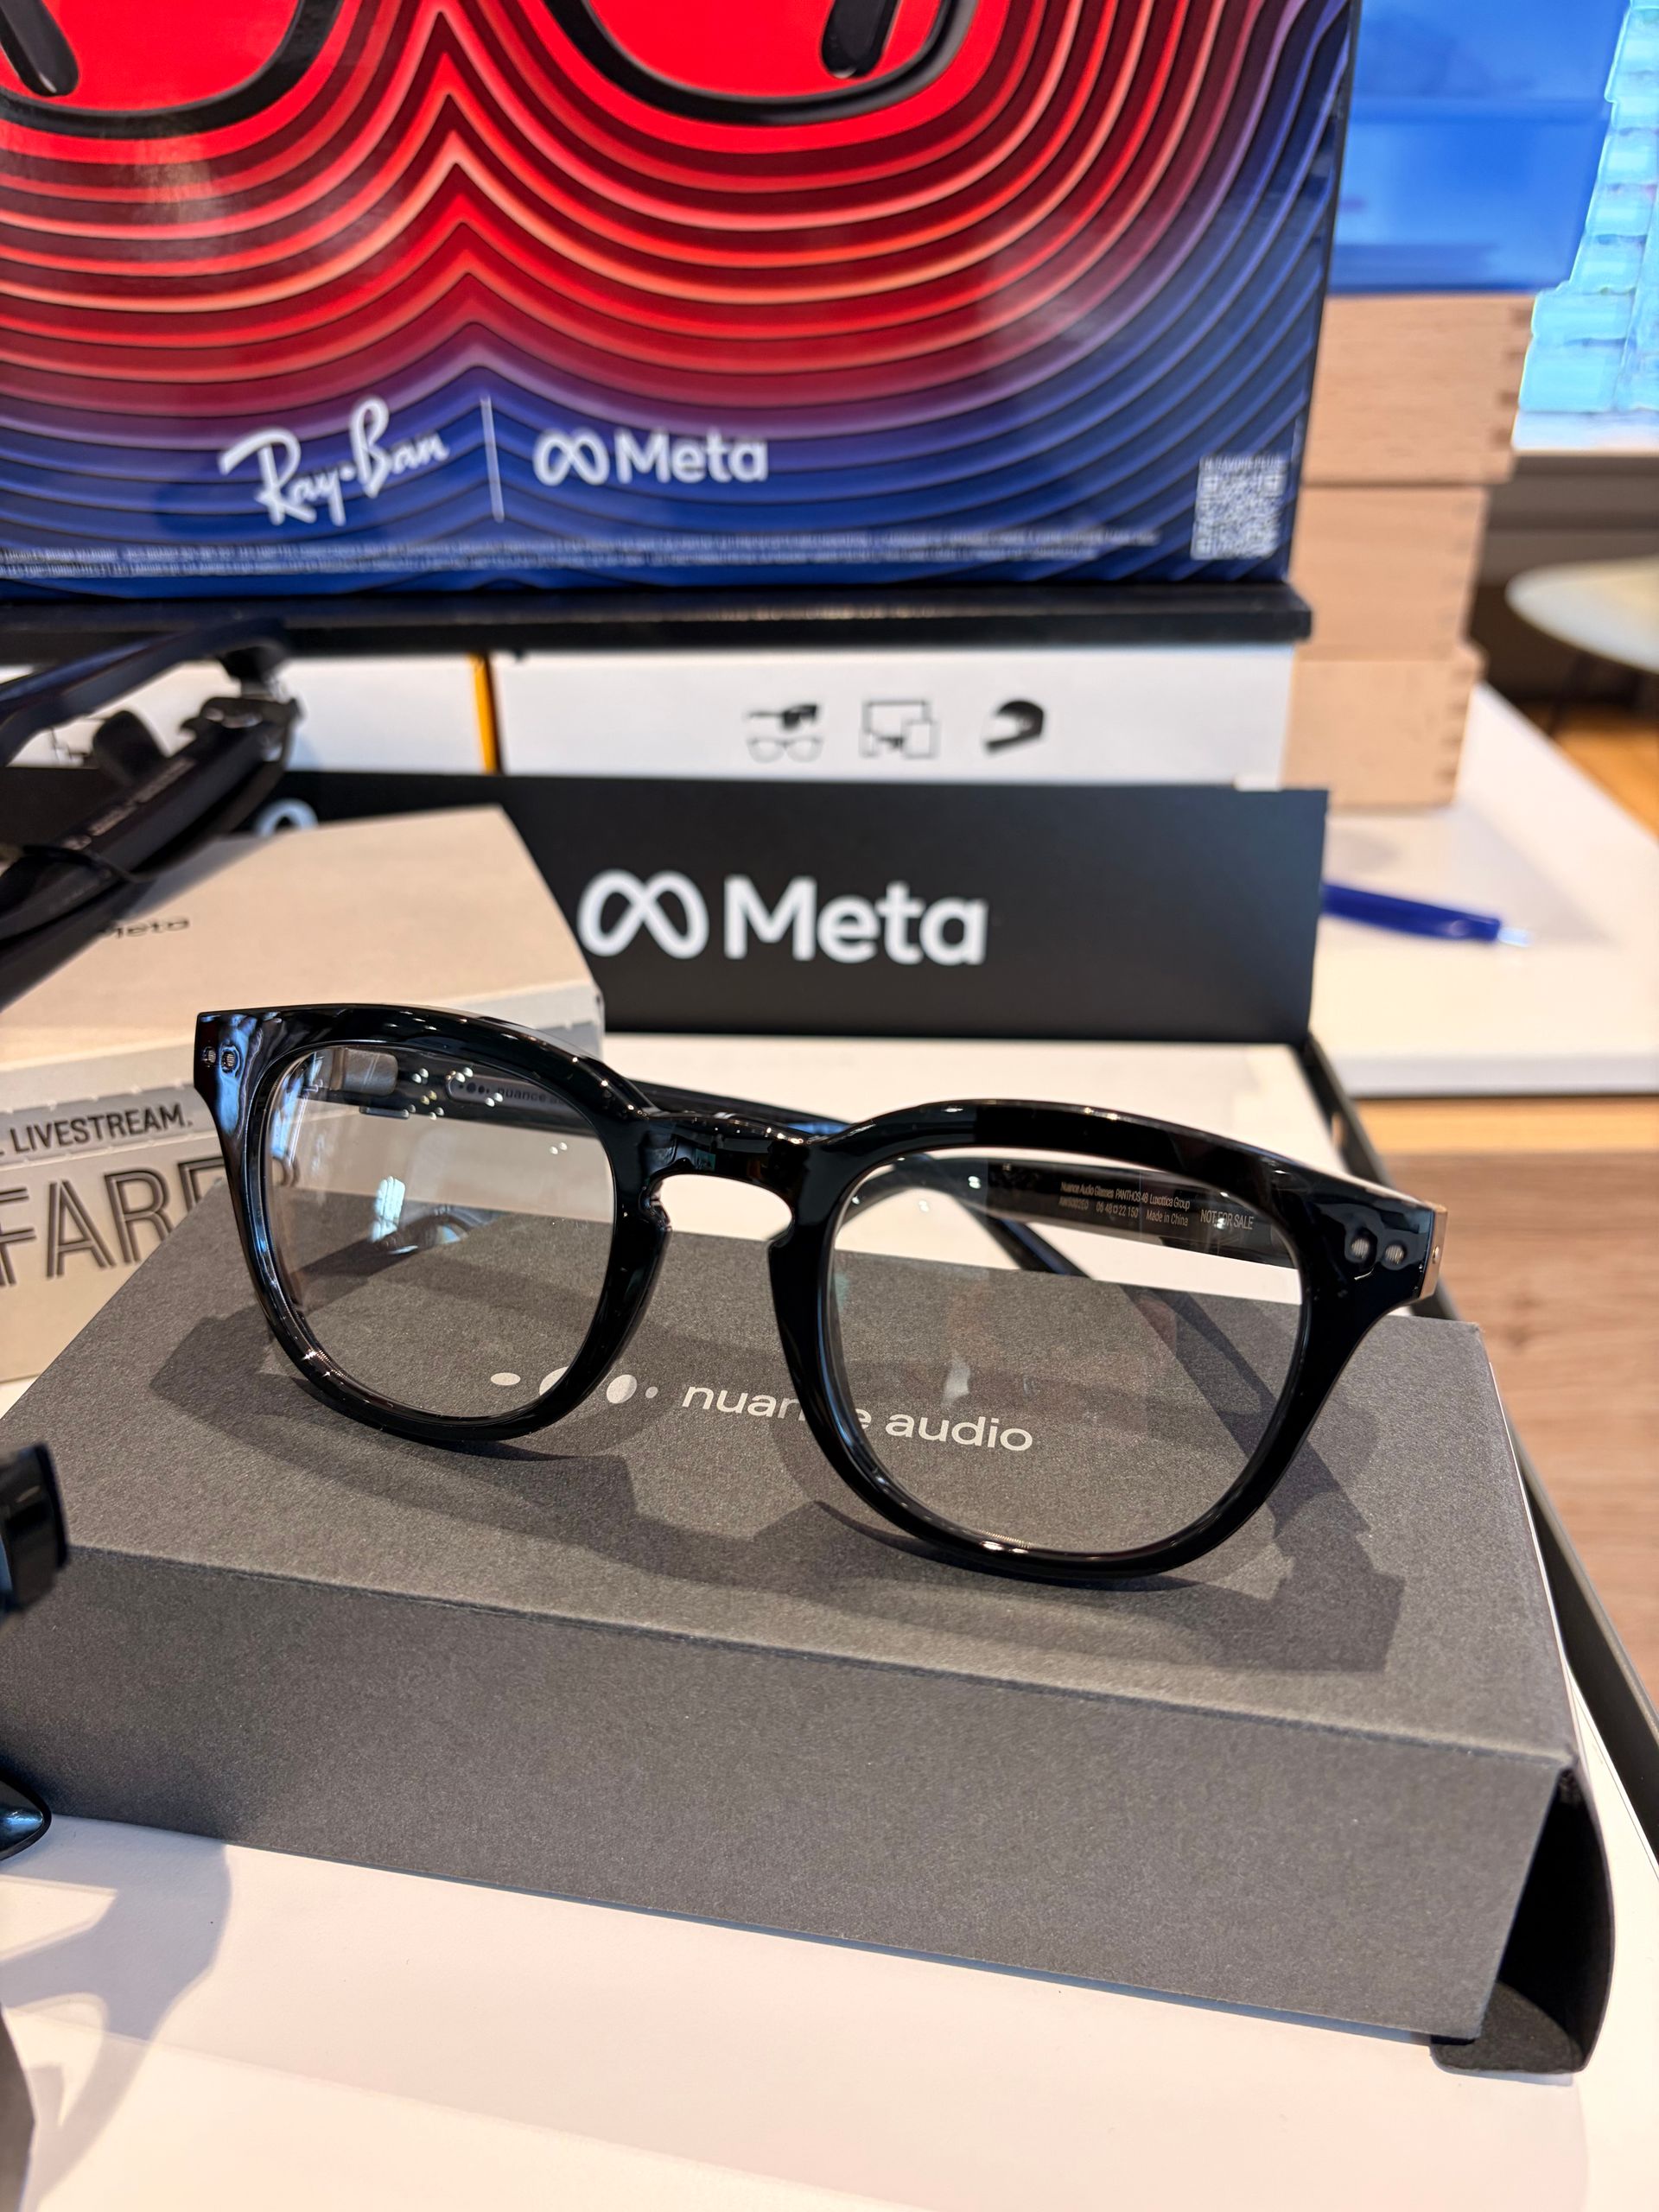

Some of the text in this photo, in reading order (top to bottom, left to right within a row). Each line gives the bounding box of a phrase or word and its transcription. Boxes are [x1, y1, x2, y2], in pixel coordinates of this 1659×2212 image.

[613, 428, 768, 484] Meta
[723, 874, 988, 966] Meta
[10, 1103, 194, 1154] LIVESTREAM.
[1146, 1210, 1163, 1224] Made
[1163, 1212, 1170, 1224] in
[1171, 1213, 1189, 1226] China
[1173, 1197, 1191, 1211] Group
[1200, 1210, 1217, 1224] NOT
[1233, 1213, 1255, 1230] SALE
[681, 1385, 1033, 1452] nuane audio
